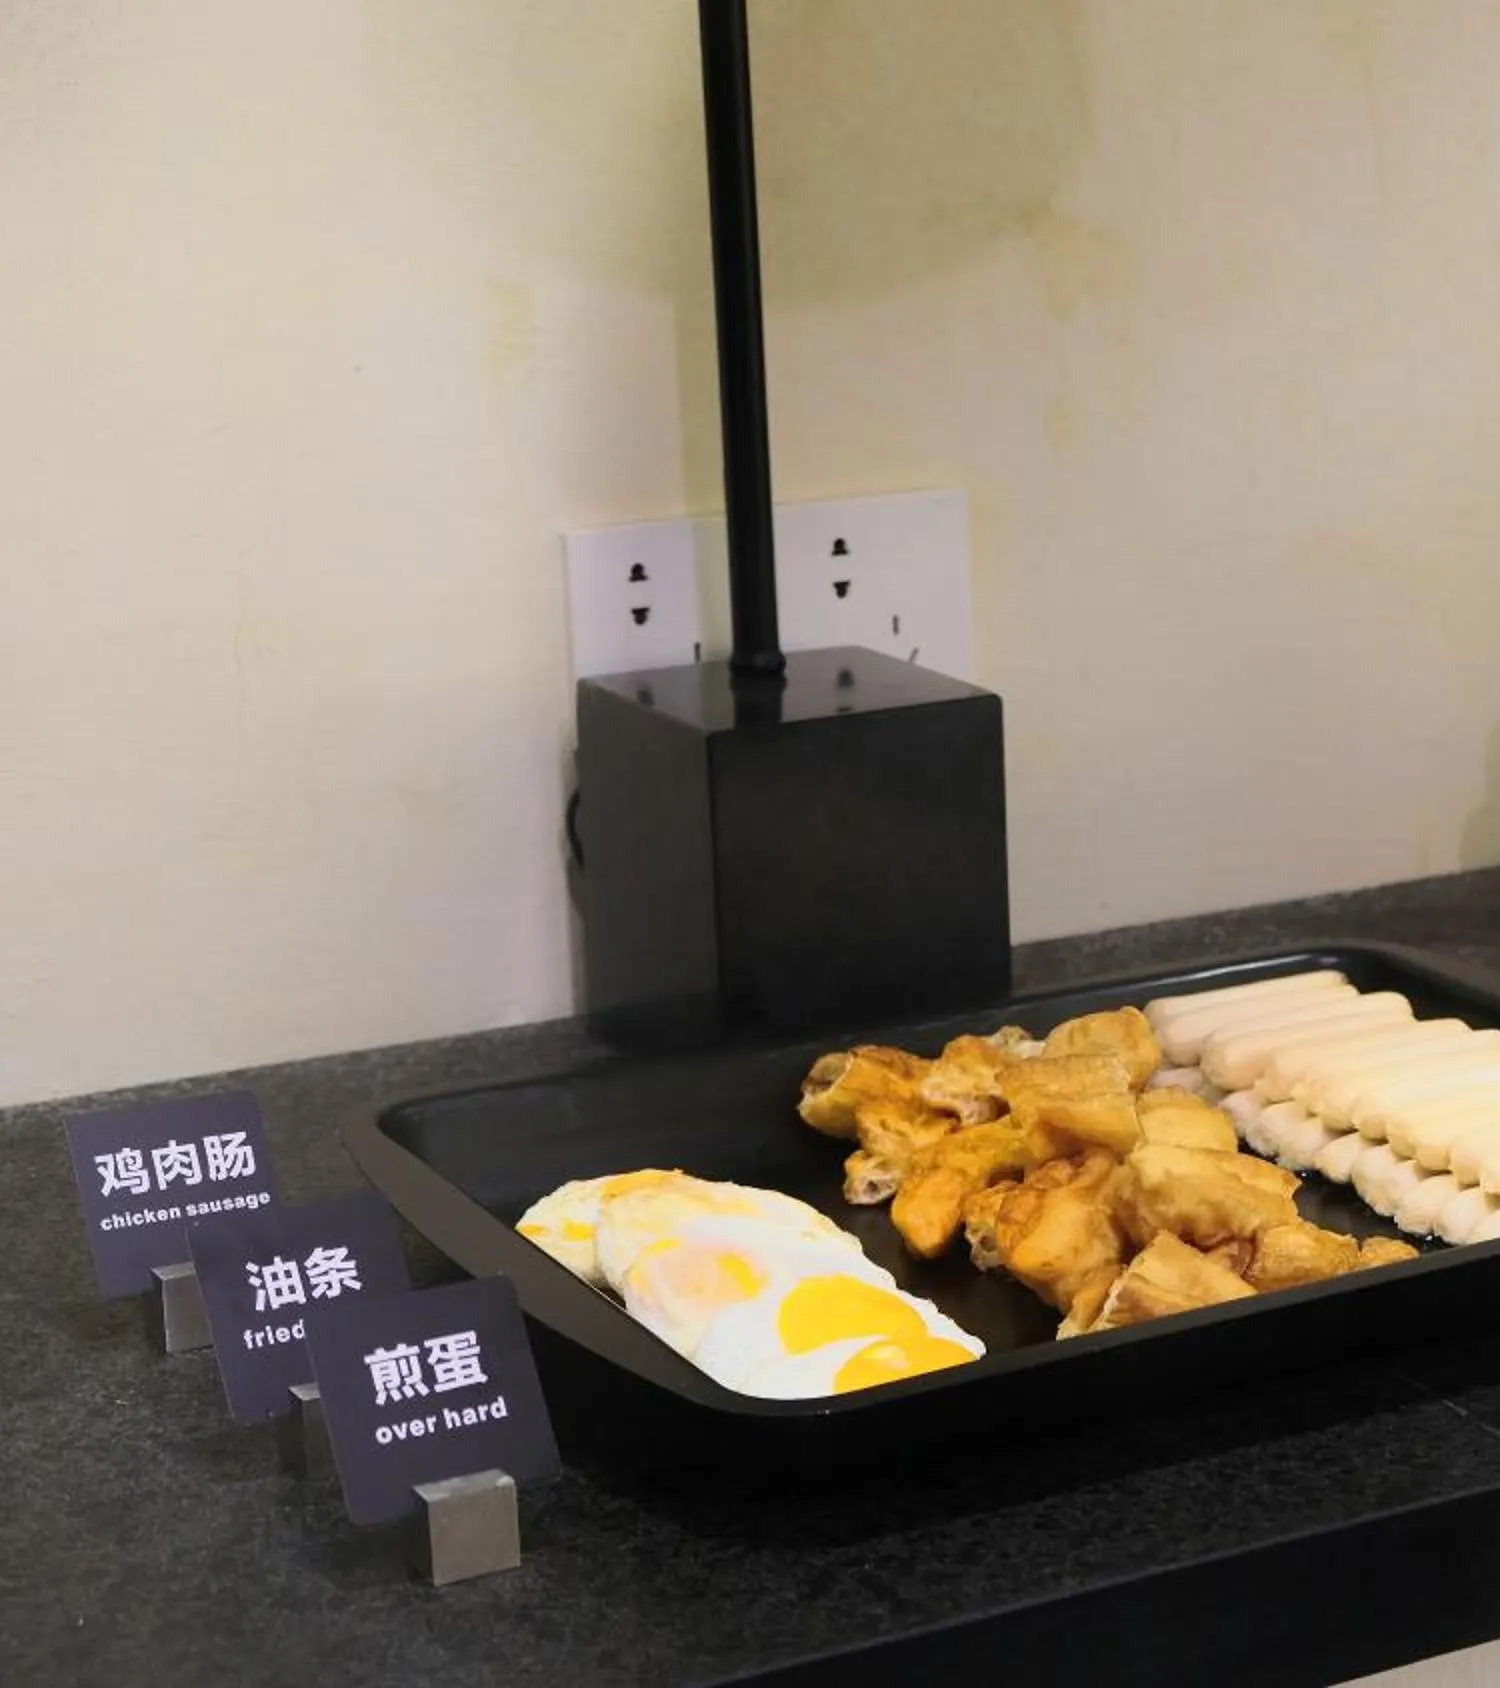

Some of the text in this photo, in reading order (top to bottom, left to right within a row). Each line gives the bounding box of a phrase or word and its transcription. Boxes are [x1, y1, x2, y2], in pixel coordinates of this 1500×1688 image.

[93, 1131, 257, 1197] 鸡肉肠
[100, 1191, 271, 1231] chicken sausage
[245, 1246, 363, 1312] 油条
[243, 1318, 305, 1350] fried
[363, 1329, 489, 1406] 煎蛋
[375, 1395, 508, 1445] over hard
